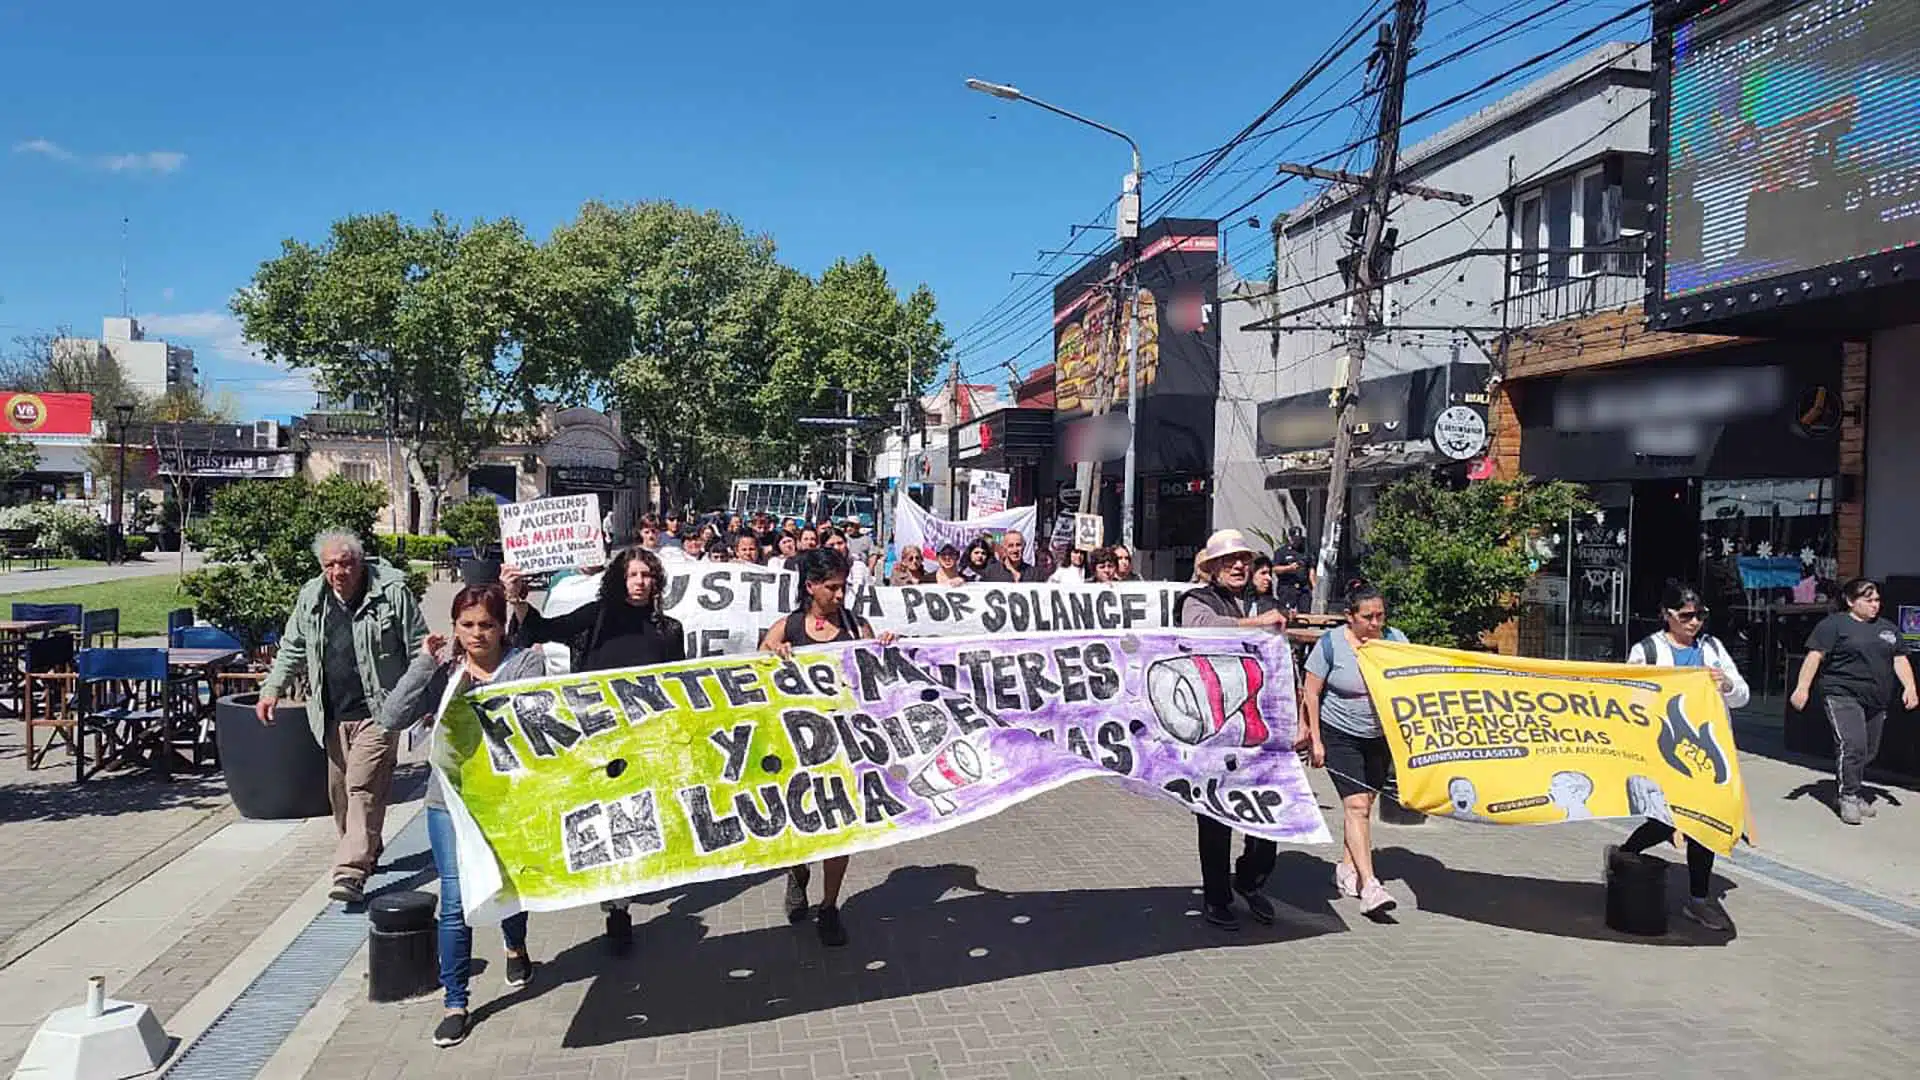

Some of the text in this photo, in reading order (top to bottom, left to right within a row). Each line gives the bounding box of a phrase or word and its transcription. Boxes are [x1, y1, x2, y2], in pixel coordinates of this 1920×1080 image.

[506, 527, 575, 550] NOS MATAN
[513, 547, 544, 561] TODAS
[546, 544, 563, 555] LAS
[901, 587, 976, 624] POR
[471, 662, 768, 773] FRENTE
[774, 656, 835, 698] de
[1391, 689, 1651, 727] DEFENSORÍAS
[1399, 714, 1553, 740] DE INFANCIAS
[1424, 728, 1611, 751] ADOLESCENCIAS
[1412, 747, 1522, 767] FEMINISMO CLASISTA
[564, 769, 906, 873] EN LUCHA
